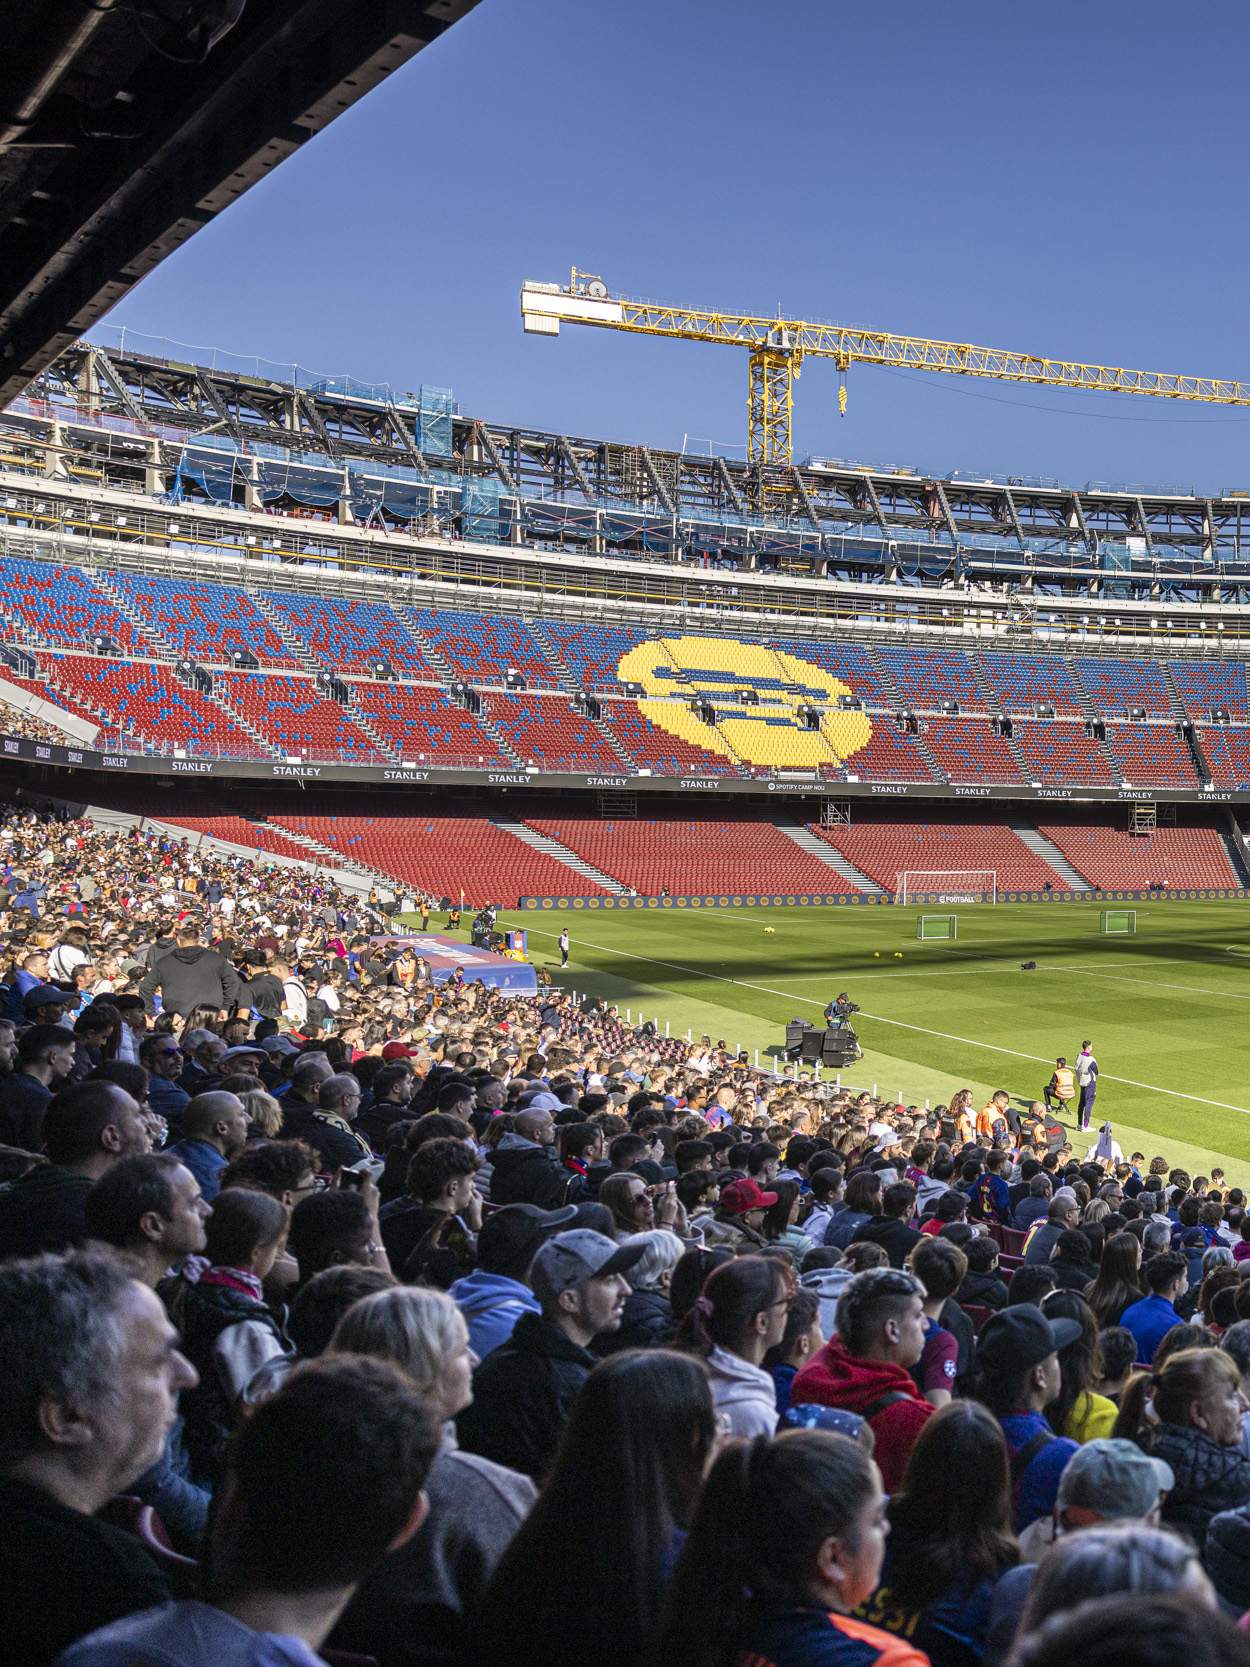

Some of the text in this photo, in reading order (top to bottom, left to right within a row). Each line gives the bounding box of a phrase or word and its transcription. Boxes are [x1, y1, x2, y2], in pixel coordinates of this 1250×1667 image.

[102, 757, 128, 767] STANLEY
[172, 762, 212, 772] STANLEY
[272, 766, 320, 776] STANLEY
[384, 770, 429, 780] STANLEY
[488, 774, 531, 783] STANLEY
[586, 778, 628, 786] STANLEY
[680, 780, 719, 789] STANLEY
[871, 786, 908, 794] STANLEY
